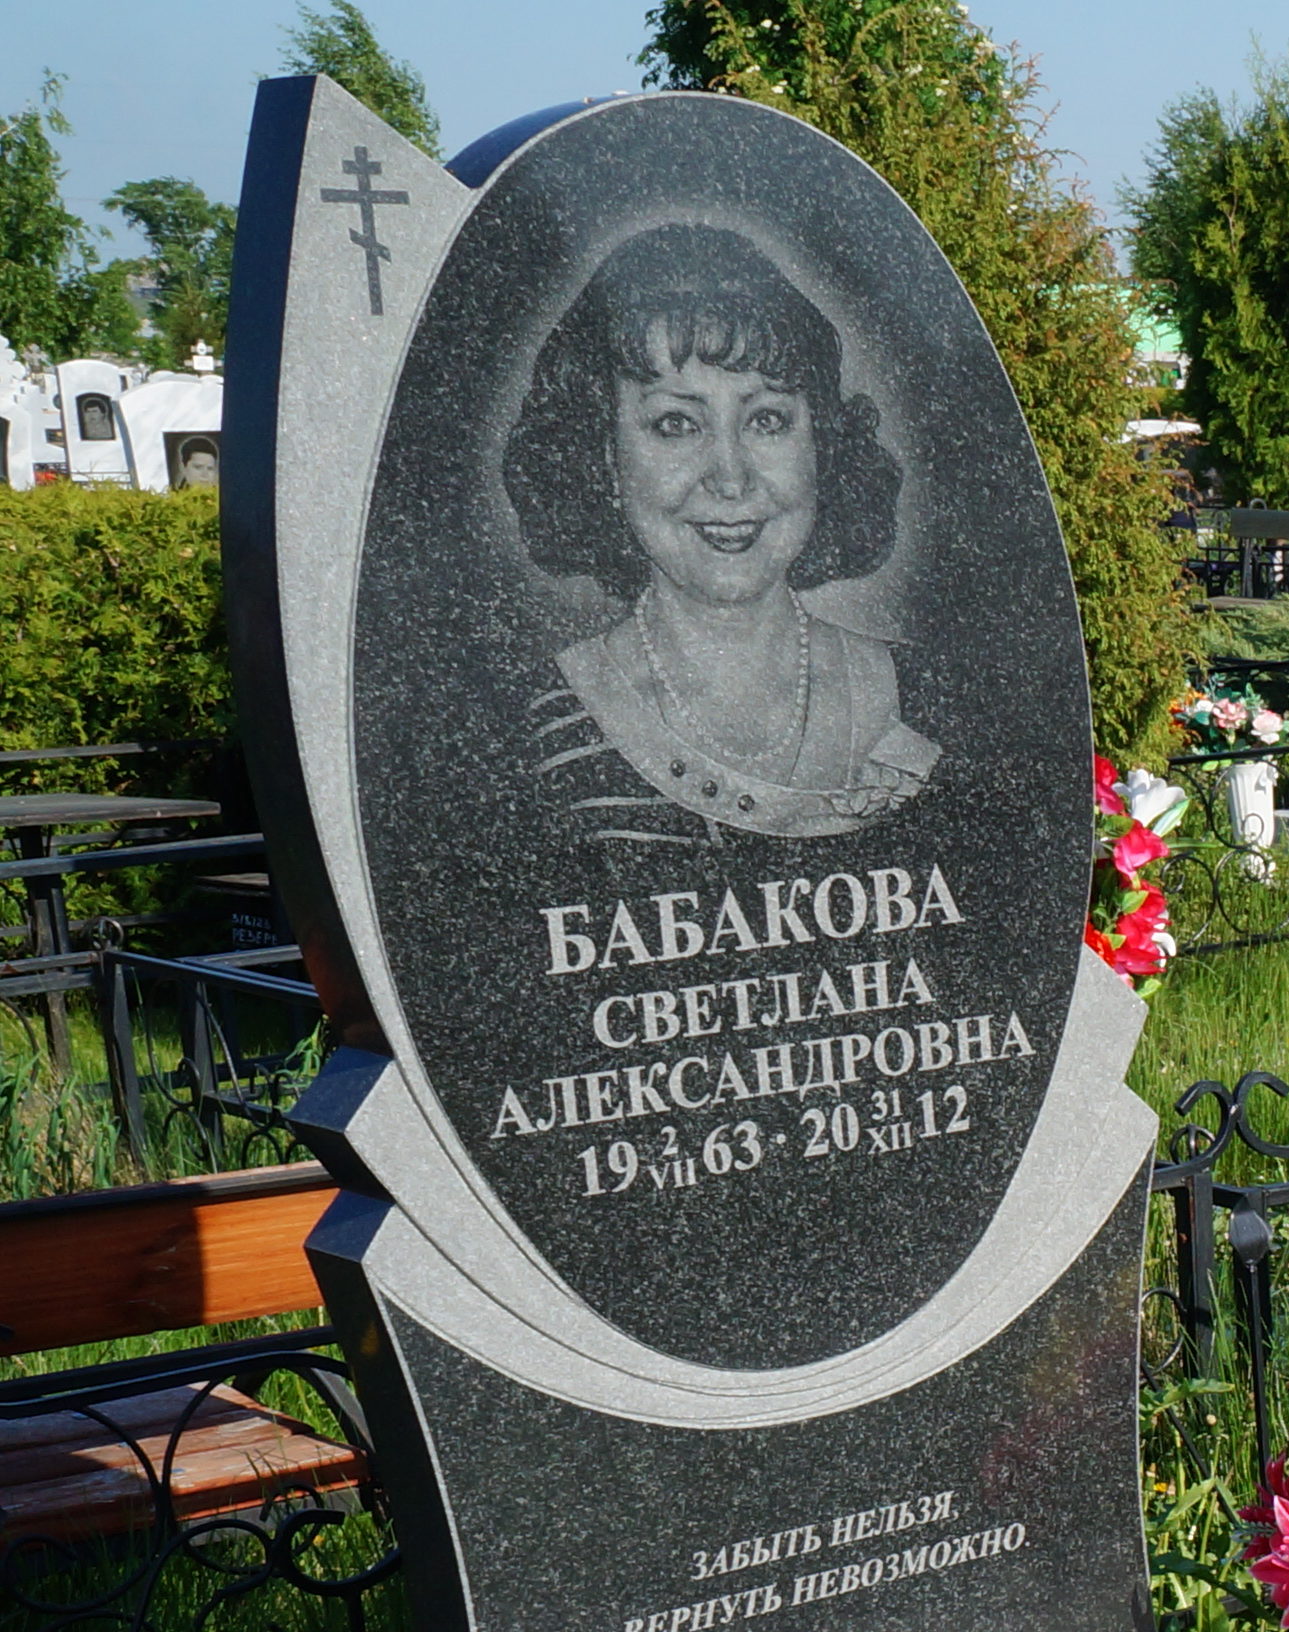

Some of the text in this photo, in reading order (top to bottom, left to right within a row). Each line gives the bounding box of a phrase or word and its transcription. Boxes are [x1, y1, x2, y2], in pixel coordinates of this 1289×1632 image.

[539, 862, 966, 976] БАБАКОВА
[593, 957, 936, 1049] СВЕТЛАНА
[490, 1010, 1037, 1140] АЛЕКСАНДРОВНА
[690, 1490, 961, 1581] ЗАБЫТЬ НЕЛЬЗЯ,
[792, 1522, 1031, 1606] НЕВОЗМОЖНО.
